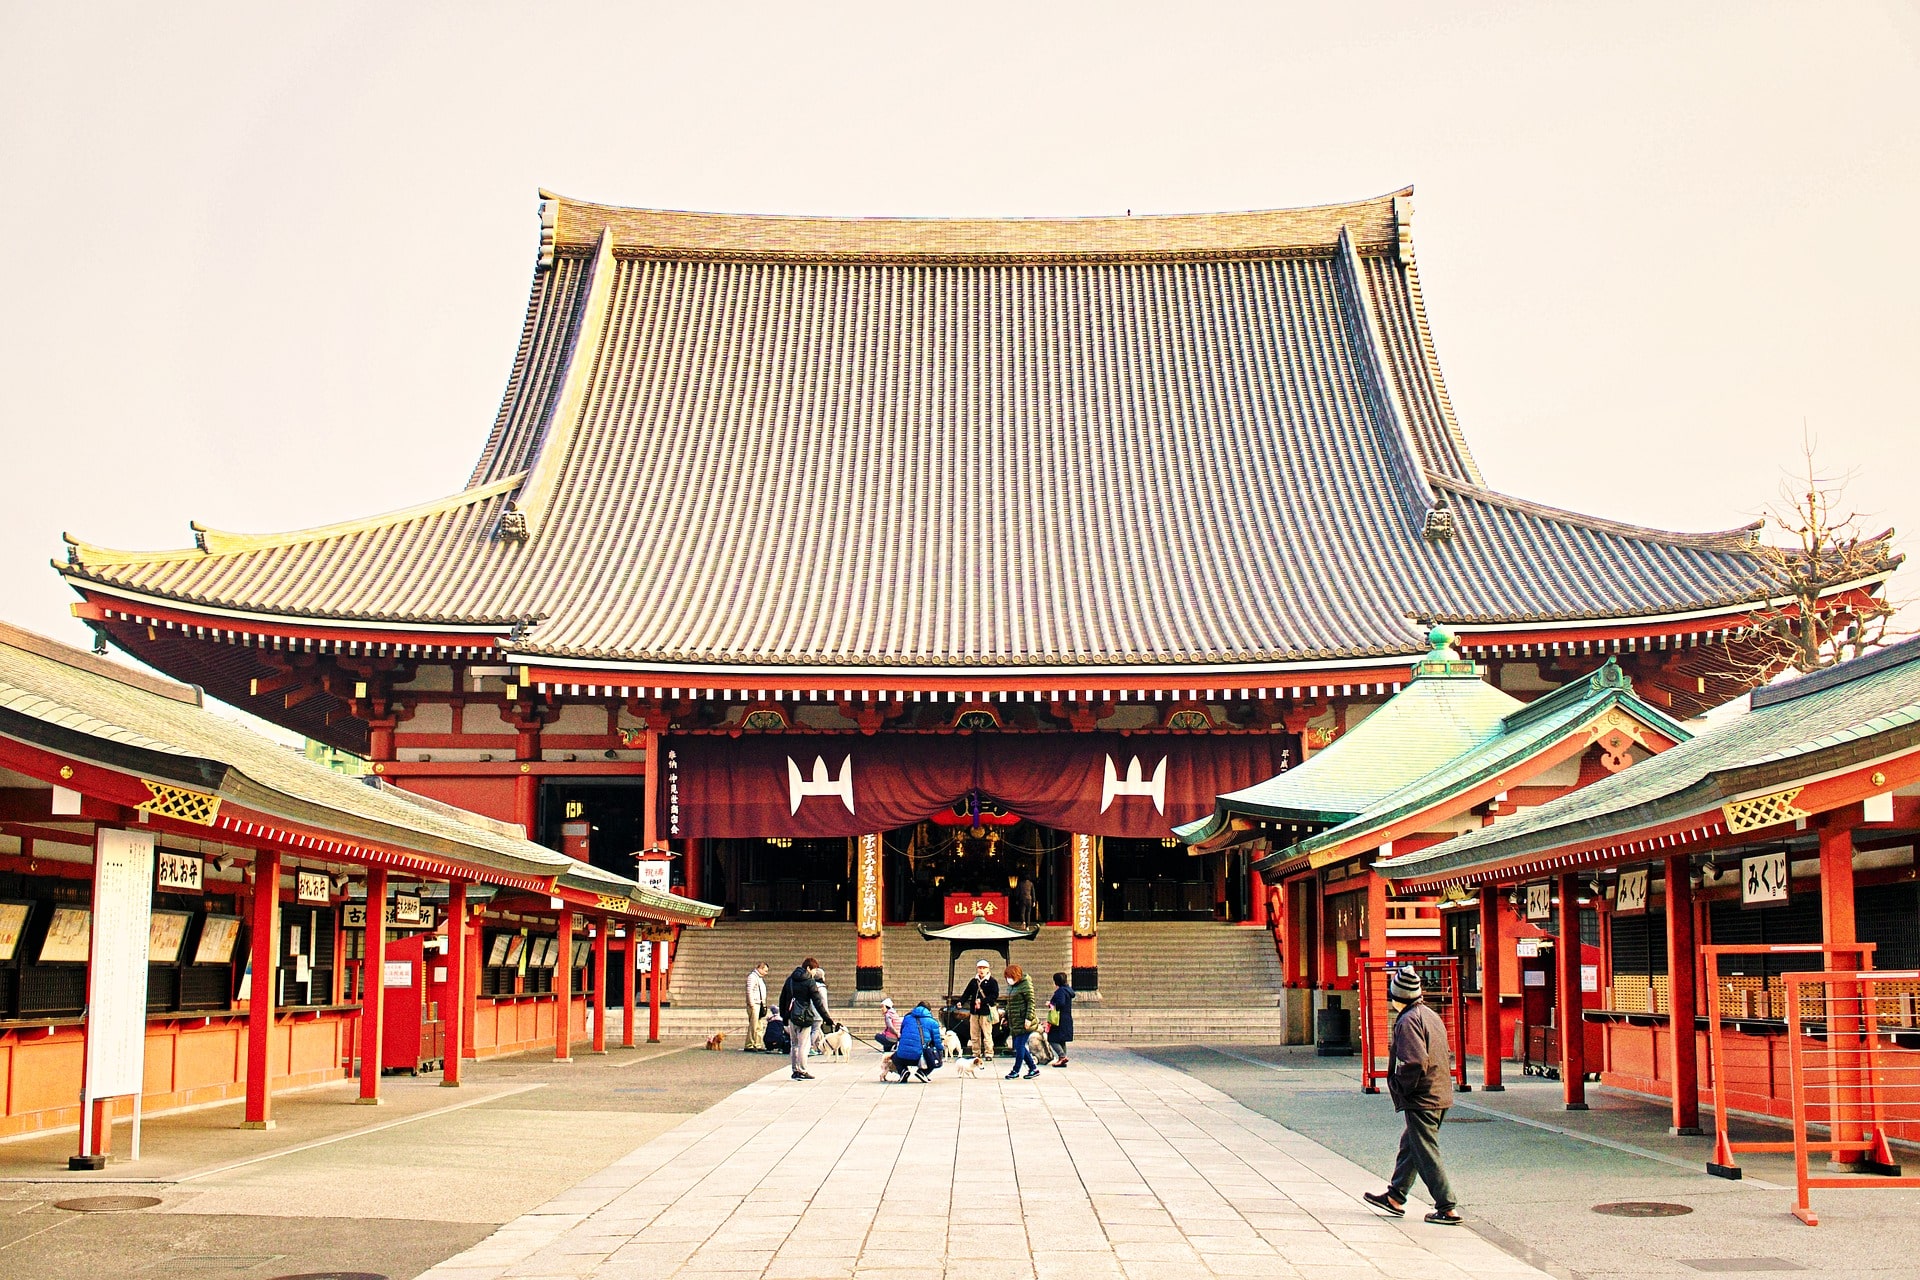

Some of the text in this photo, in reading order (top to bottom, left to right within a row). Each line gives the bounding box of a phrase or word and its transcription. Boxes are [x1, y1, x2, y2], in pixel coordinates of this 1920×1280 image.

[668, 750, 677, 769] 奉納
[1280, 749, 1290, 773] 平成
[160, 856, 198, 886] お札お守
[1748, 859, 1785, 895] みくじ
[299, 877, 326, 898] お札お守
[1620, 875, 1647, 903] みくじ
[1530, 888, 1549, 912] みくじ
